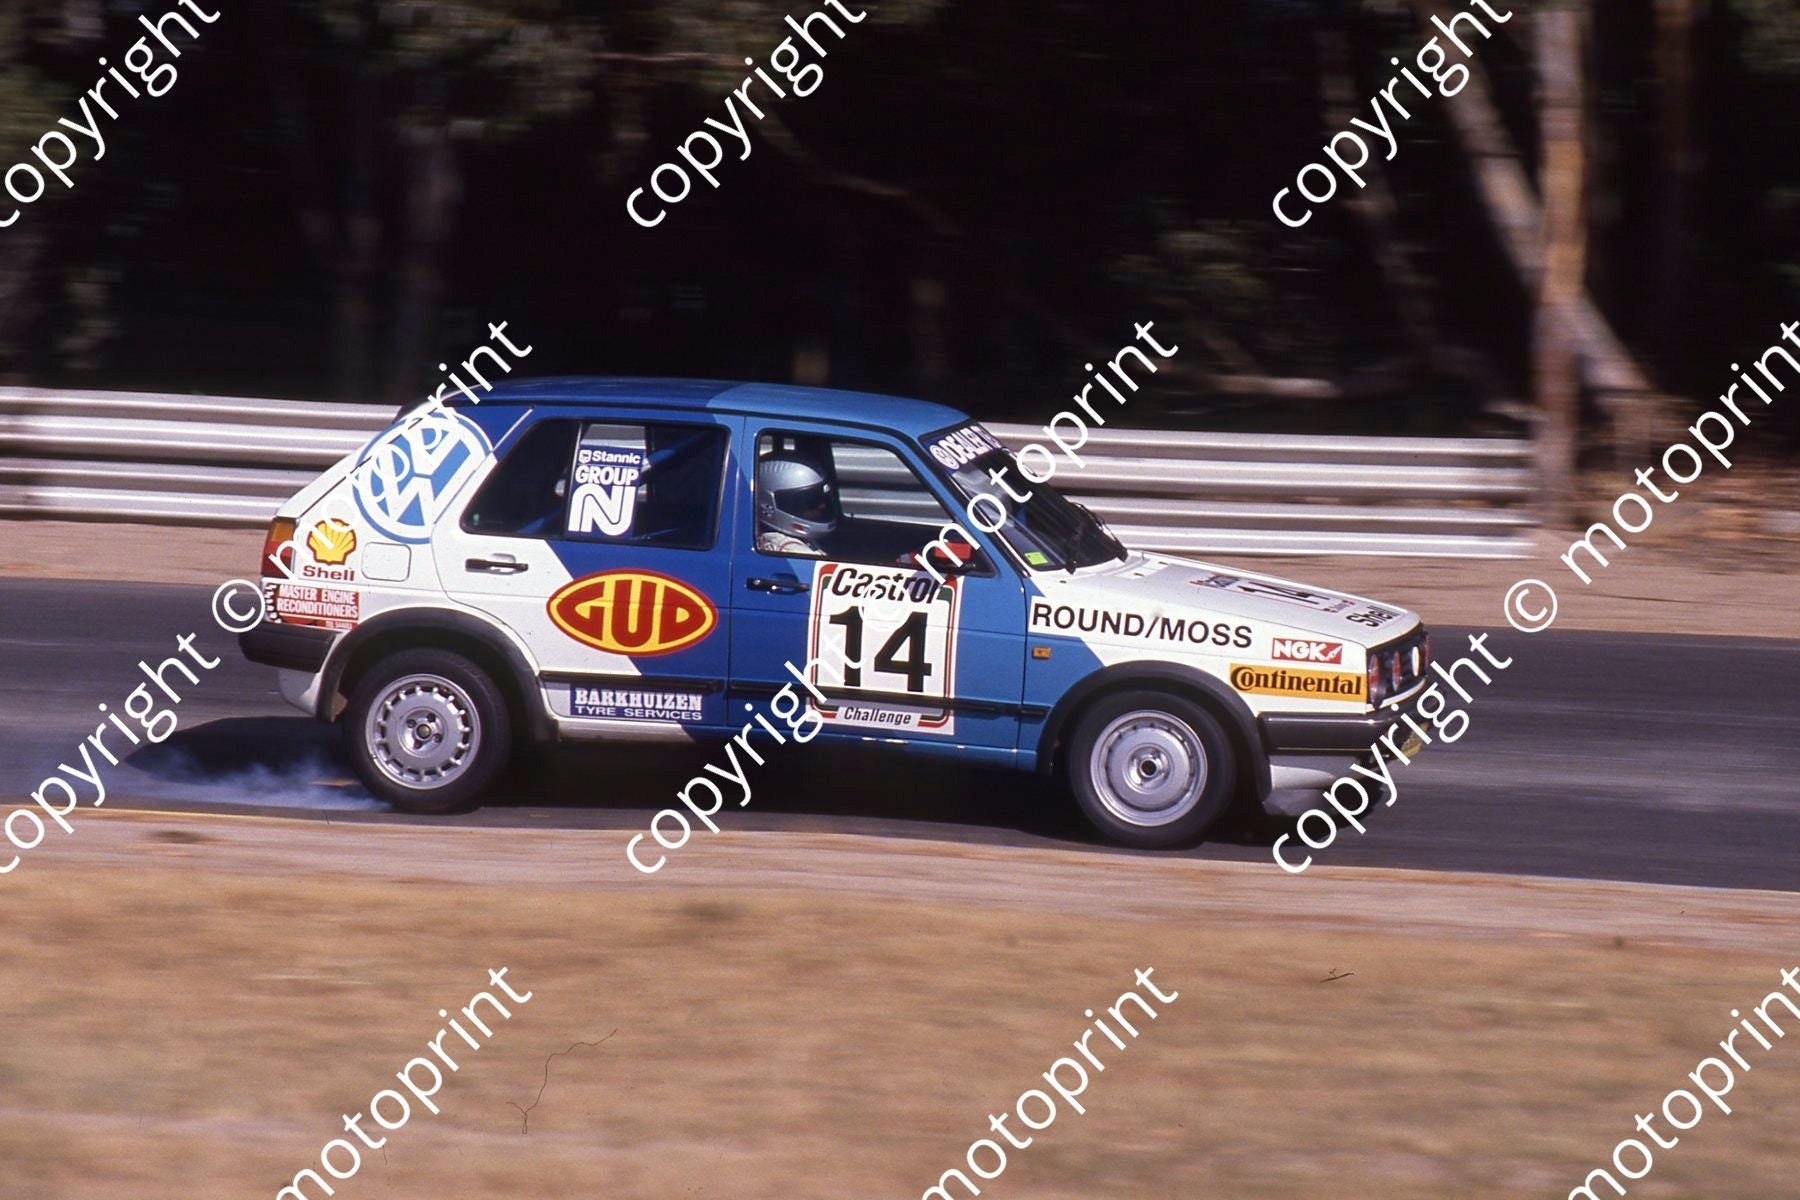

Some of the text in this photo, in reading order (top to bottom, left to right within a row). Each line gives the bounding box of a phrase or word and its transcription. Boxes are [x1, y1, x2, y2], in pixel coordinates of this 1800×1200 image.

[592, 451, 640, 464] Stannic
[575, 465, 639, 485] GROUP
[568, 484, 636, 536] N
[303, 565, 355, 581] Shell
[279, 584, 356, 605] MASTER ENGINE
[832, 568, 942, 604] Castrol
[277, 598, 358, 618] RECONDITIONERS
[555, 577, 707, 648] GUD
[1032, 602, 1253, 648] ROUND/MOSS
[829, 606, 932, 692] 14
[1273, 639, 1328, 661] NGK
[1231, 667, 1362, 695] Continental
[575, 688, 702, 711] BARKHUIZEN
[576, 705, 702, 720] TYRE SERVICES
[843, 705, 912, 725] Challenge
